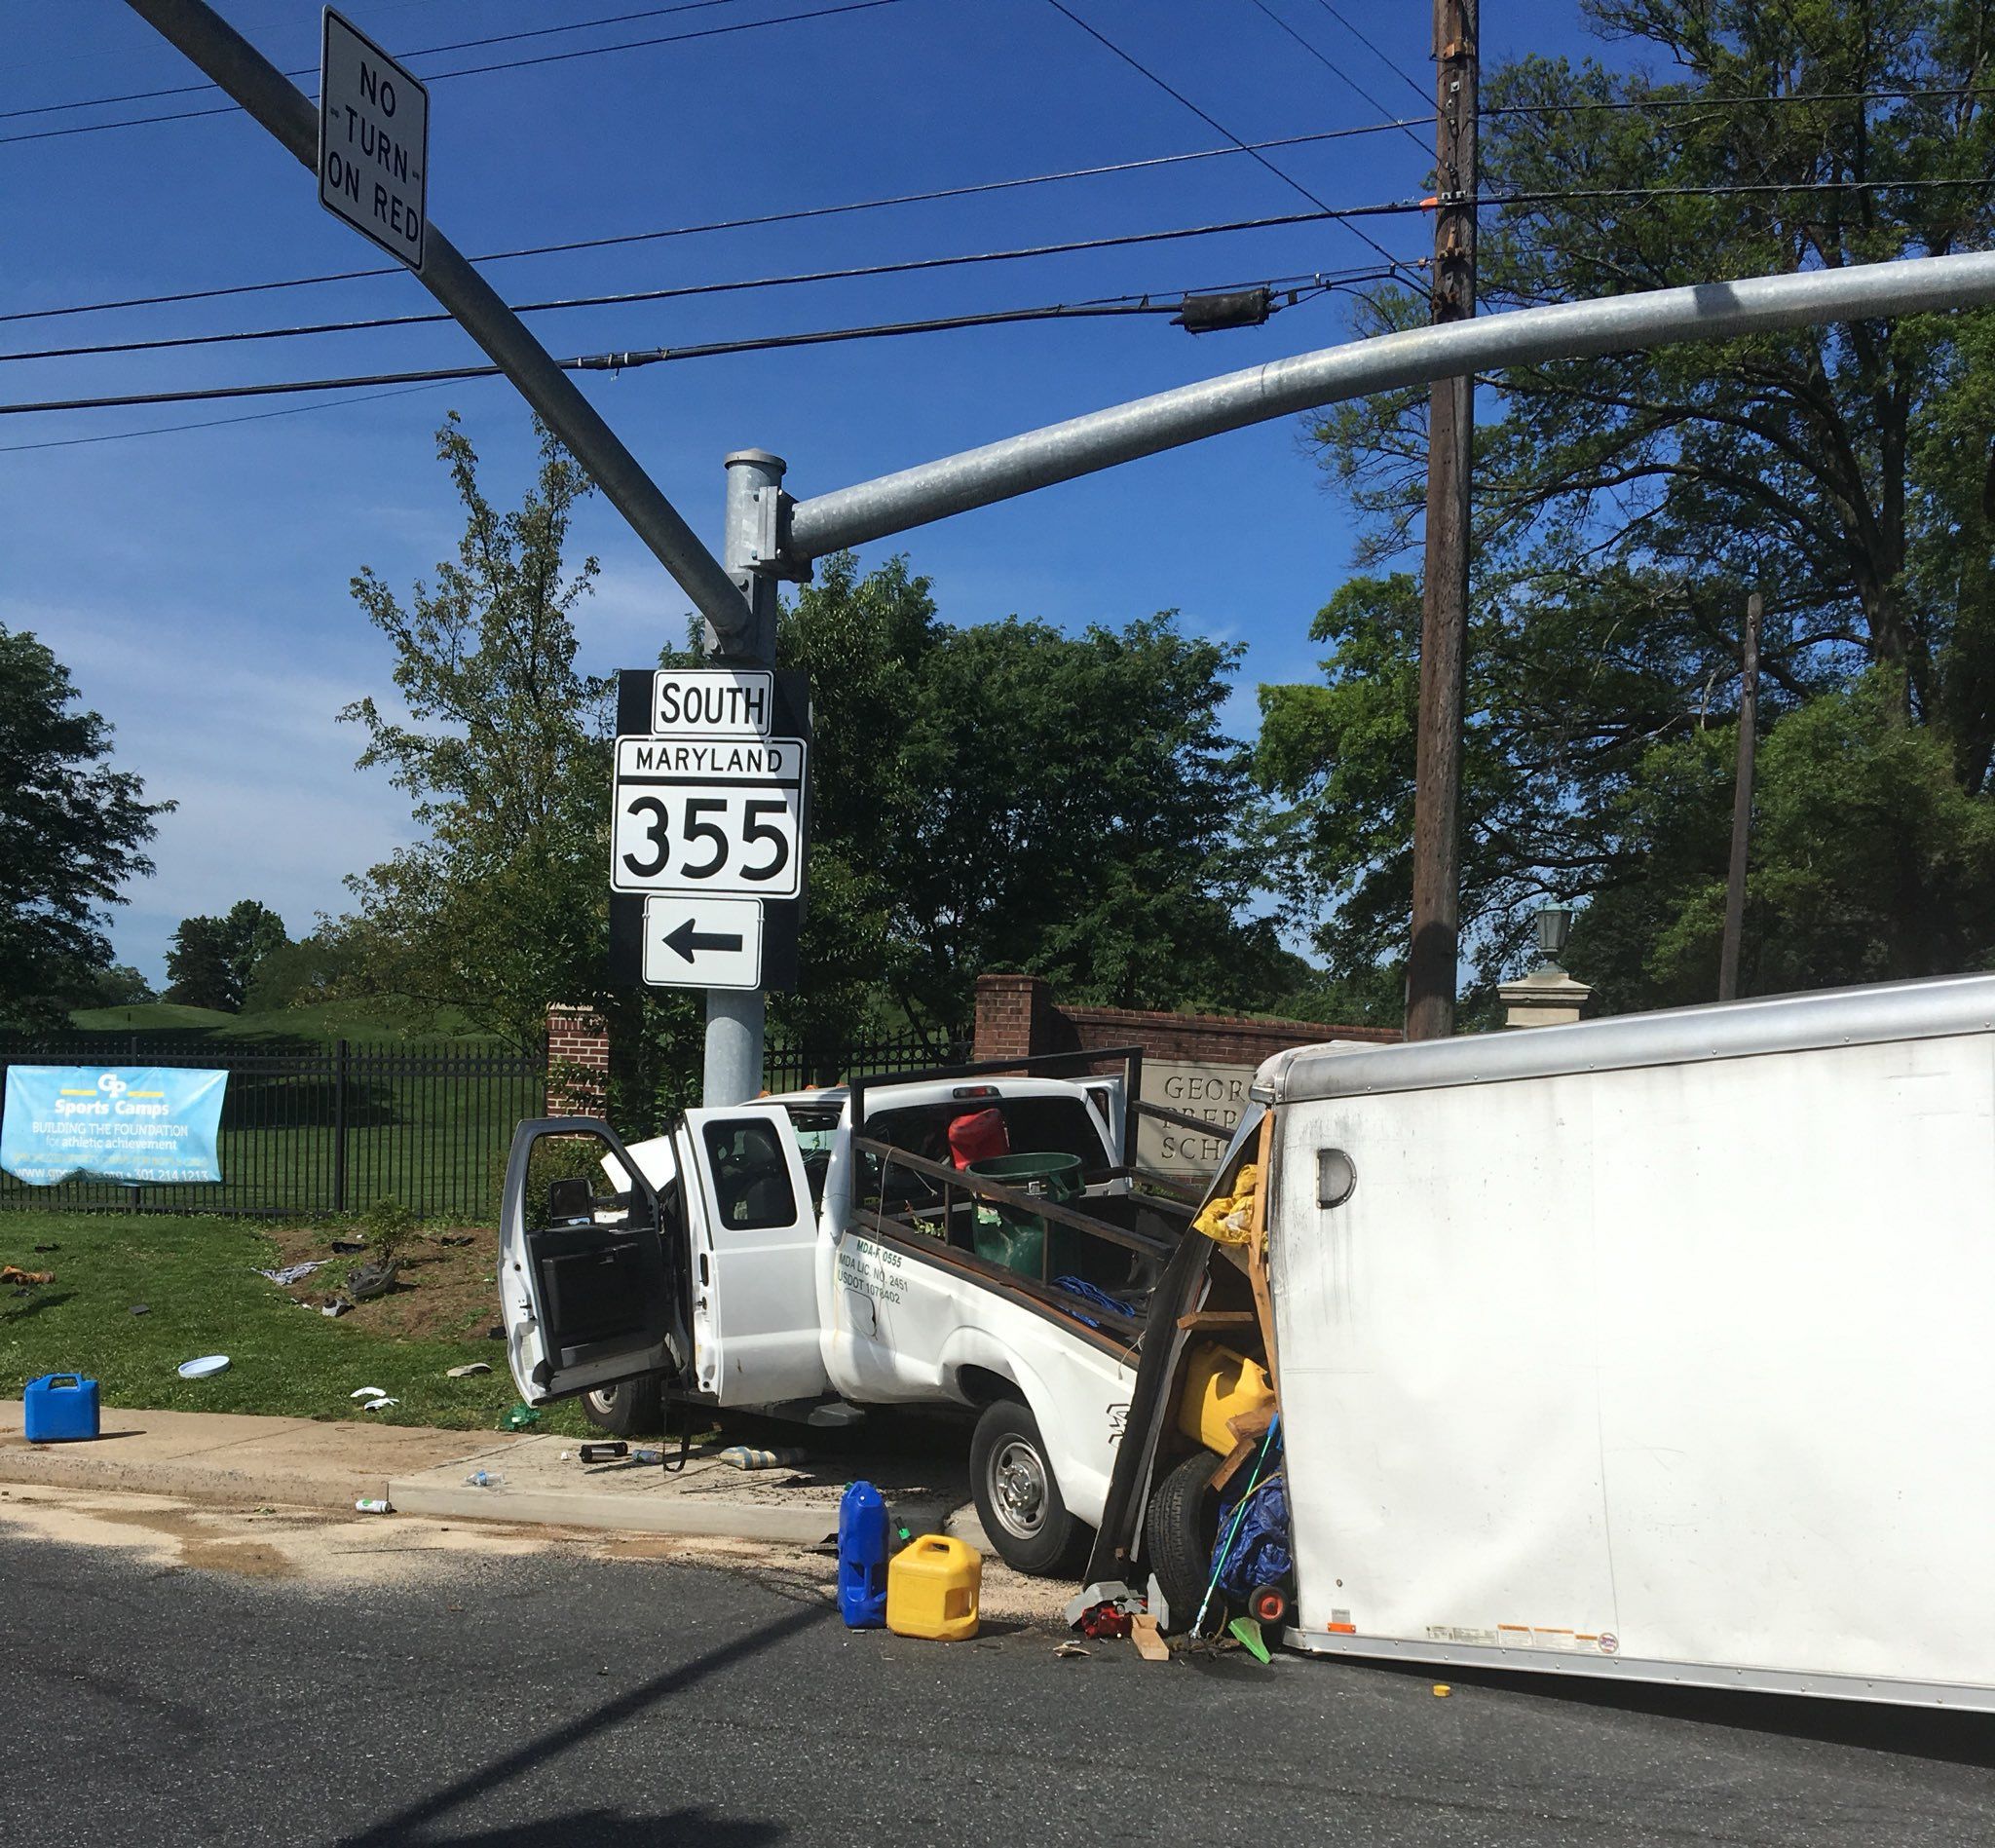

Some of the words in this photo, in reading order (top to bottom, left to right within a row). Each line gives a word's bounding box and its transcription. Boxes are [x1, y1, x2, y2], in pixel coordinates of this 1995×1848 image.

[359, 60, 396, 118] NO
[345, 104, 408, 184] TURN
[327, 151, 360, 203] ON
[374, 182, 419, 243] RED
[659, 682, 765, 725] SOUTH
[636, 746, 783, 773] MARYLAND
[622, 795, 789, 881] 355
[97, 1073, 127, 1098] GP
[1164, 1075, 1253, 1102] GEOR
[55, 1099, 109, 1116] Sports
[115, 1101, 169, 1119] Camps
[32, 1121, 87, 1135] BUILDING
[89, 1122, 111, 1136] THE
[114, 1122, 188, 1138] FOUNDATION
[46, 1135, 60, 1147] for
[61, 1135, 102, 1149] athletic
[104, 1137, 177, 1150] achievement
[1161, 1136, 1231, 1161] SCH
[134, 1168, 156, 1181] 301
[158, 1169, 179, 1182] 214
[182, 1170, 208, 1183] 1213
[883, 1252, 902, 1267] 0555
[838, 1270, 864, 1290] USDOT
[840, 1254, 855, 1269] MDA
[889, 1275, 909, 1293] 2451
